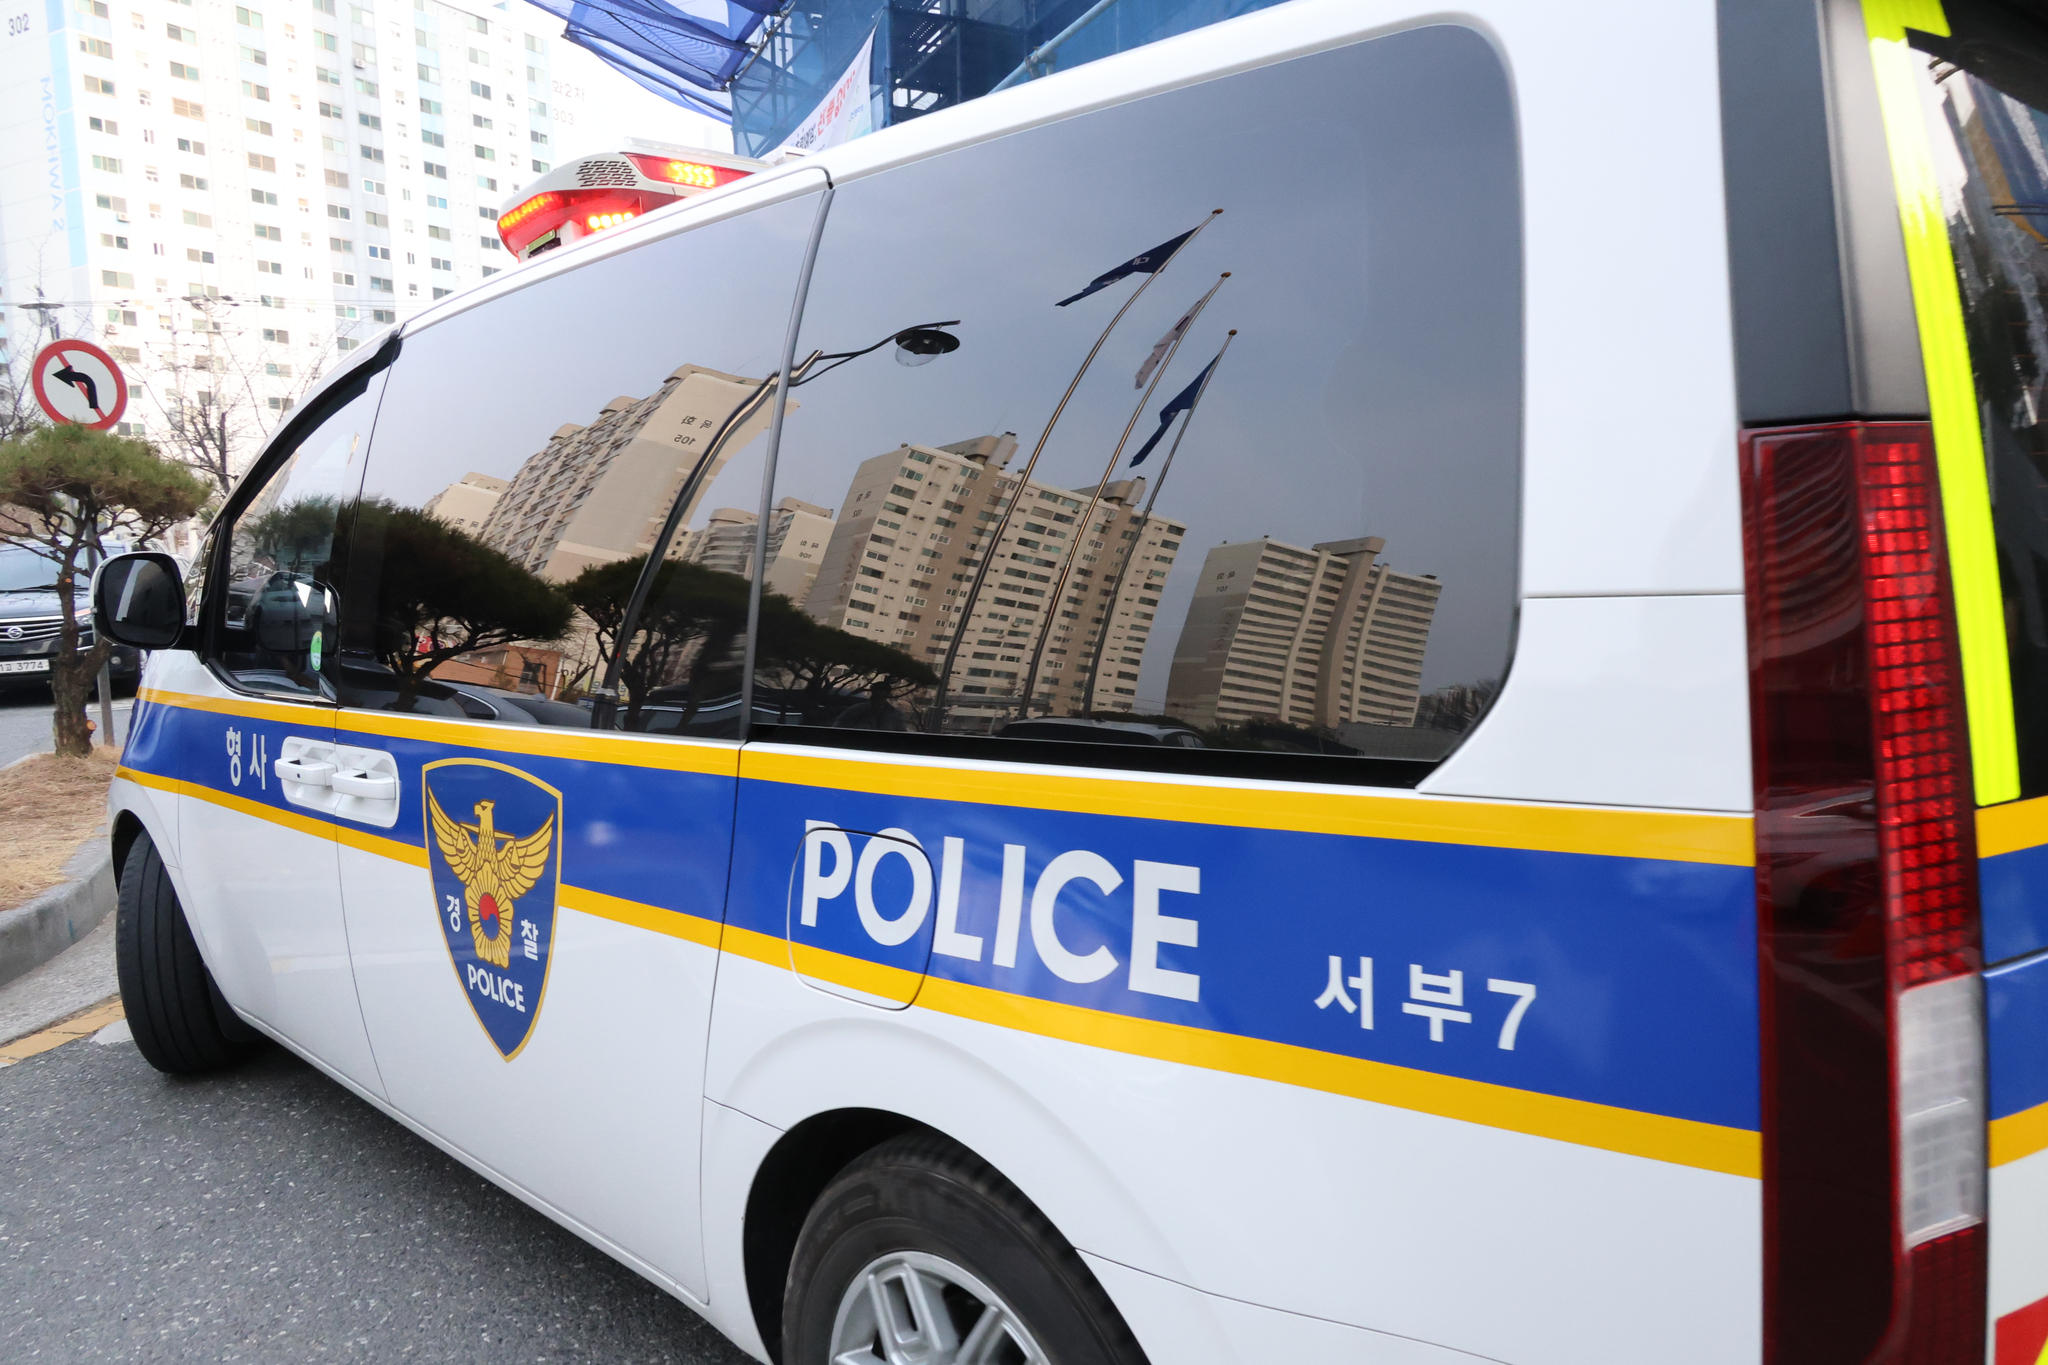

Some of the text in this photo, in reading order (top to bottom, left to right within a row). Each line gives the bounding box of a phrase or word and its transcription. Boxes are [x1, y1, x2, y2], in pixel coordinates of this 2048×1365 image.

[8, 12, 30, 36] 302
[40, 76, 63, 211] MOKHWA
[225, 726, 267, 791] 형사
[801, 819, 1201, 1003] POLICE
[467, 963, 526, 1013] POLICE
